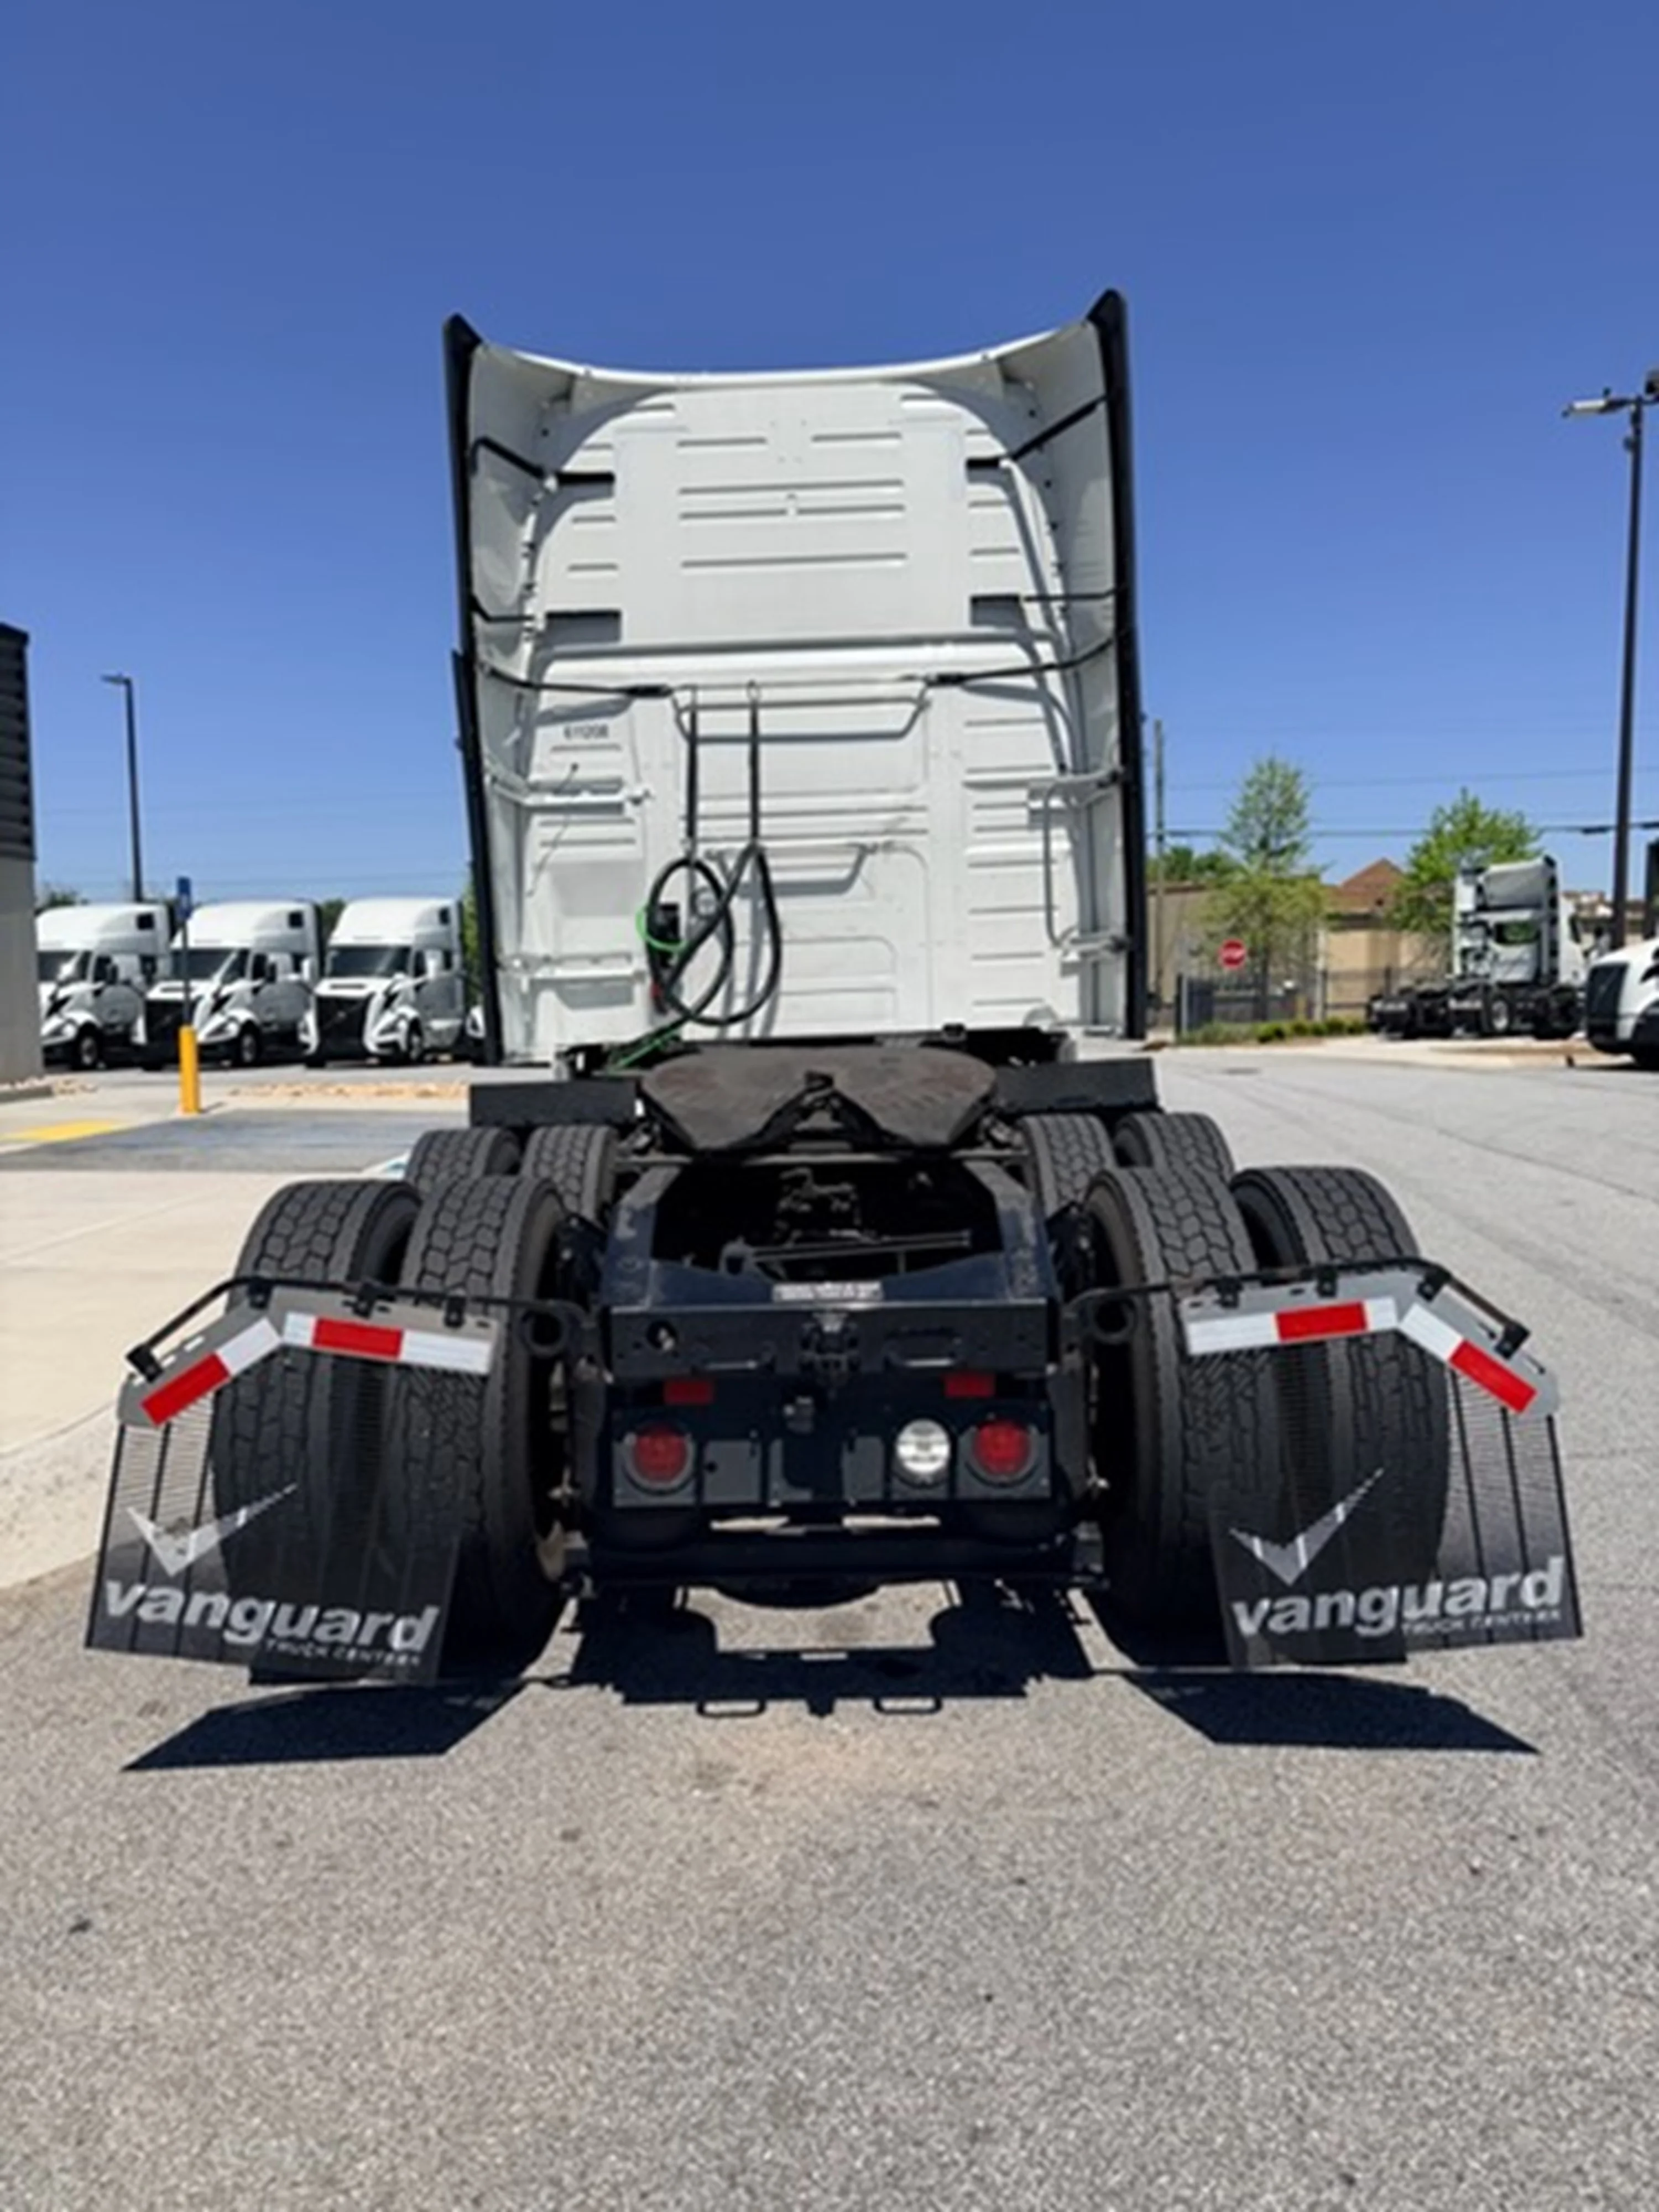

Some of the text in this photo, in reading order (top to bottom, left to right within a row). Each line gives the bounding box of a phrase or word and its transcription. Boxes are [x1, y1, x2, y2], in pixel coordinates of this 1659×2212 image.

[106, 1580, 439, 1652] vanguard
[1232, 1555, 1564, 1637] vanguard
[267, 1638, 328, 1658] TRUCK
[1402, 1618, 1464, 1635] TRUCK
